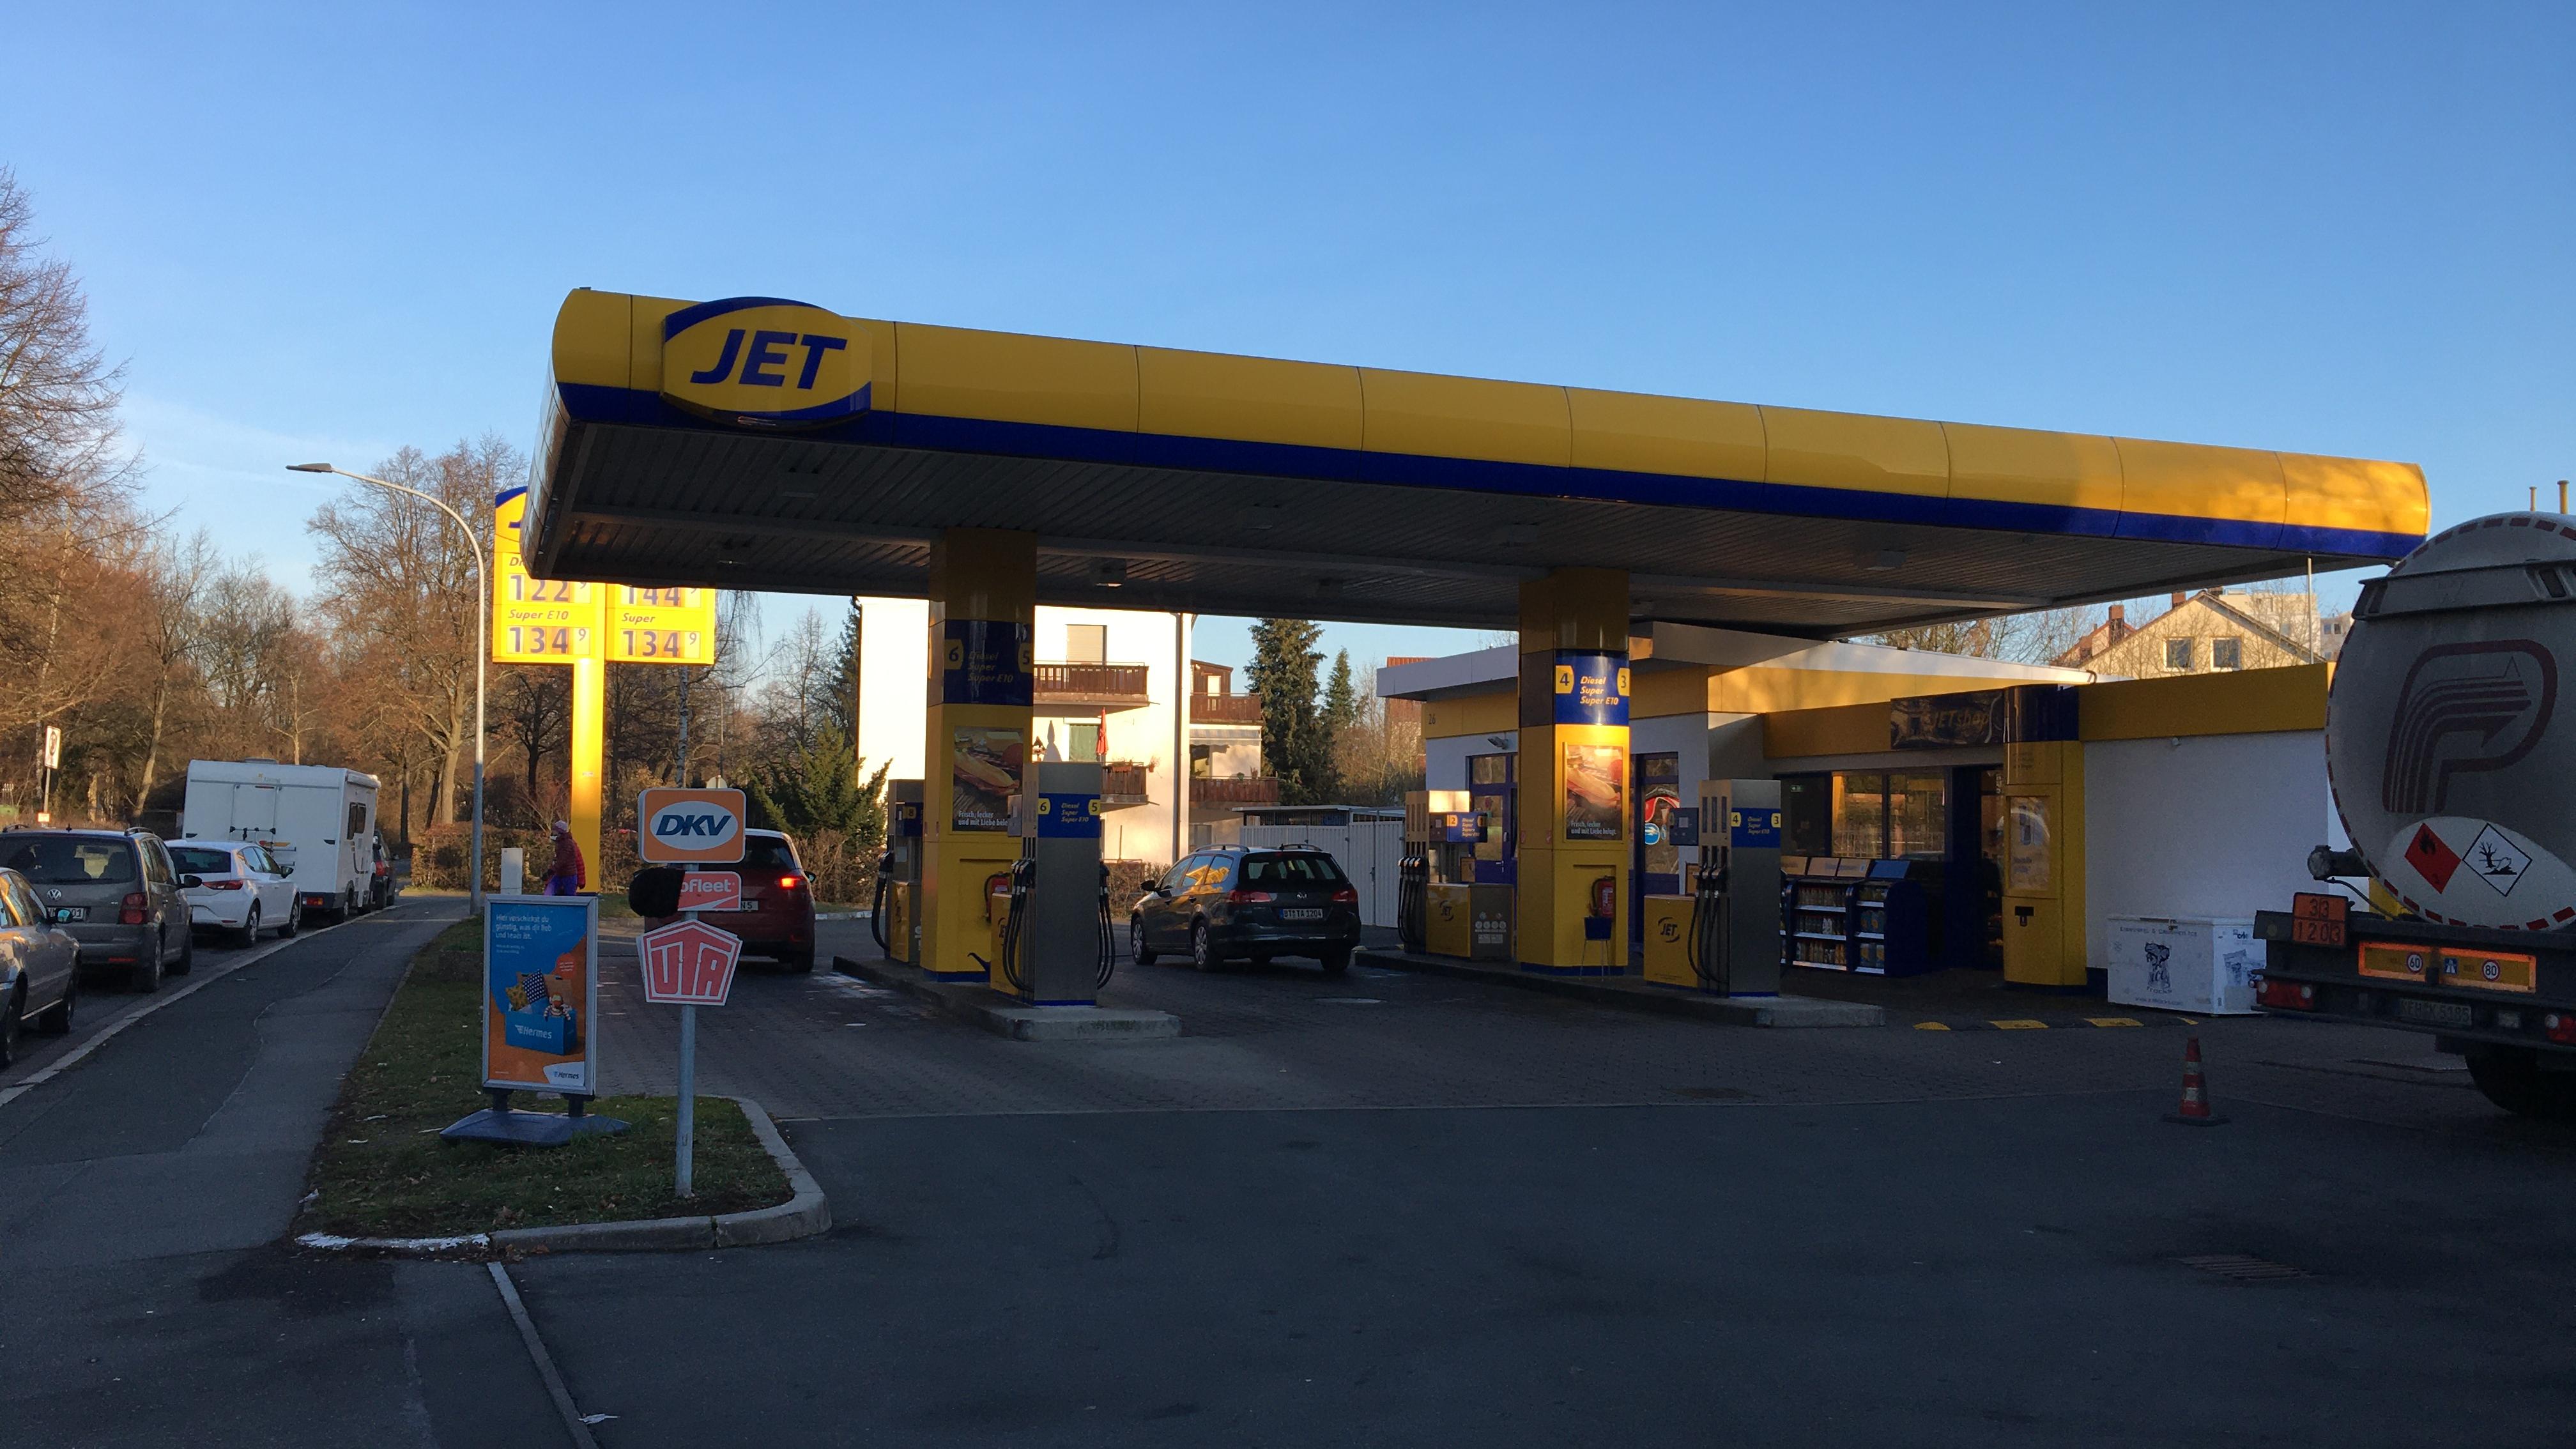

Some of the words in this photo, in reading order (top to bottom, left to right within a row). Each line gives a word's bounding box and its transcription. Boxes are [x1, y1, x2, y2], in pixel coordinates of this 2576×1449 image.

[690, 329, 848, 390] JET
[508, 609, 543, 622] Super
[547, 610, 569, 620] E10
[622, 613, 656, 625] Super
[949, 646, 958, 661] 6
[969, 651, 999, 660] Diesel
[967, 663, 996, 673] Super
[967, 673, 995, 684] Super
[997, 674, 1014, 683] E10
[1560, 673, 1570, 686] 4
[1580, 676, 1607, 685] Diesel
[1621, 675, 1627, 689] 3
[1579, 686, 1604, 696] Super
[1579, 696, 1604, 706] Super
[1606, 697, 1619, 705] E10
[1040, 802, 1046, 811] 6
[1092, 802, 1098, 812] 5
[656, 815, 733, 836] DKV
[1774, 815, 1779, 824] 3
[681, 878, 732, 893] ofleet
[2310, 898, 2329, 917] 33
[1660, 923, 1678, 936] JET
[2298, 921, 2341, 942] 1203
[650, 927, 733, 997] UTA
[2409, 958, 2420, 969] 60
[2485, 965, 2497, 976] 80
[523, 1027, 552, 1039] Hermes
